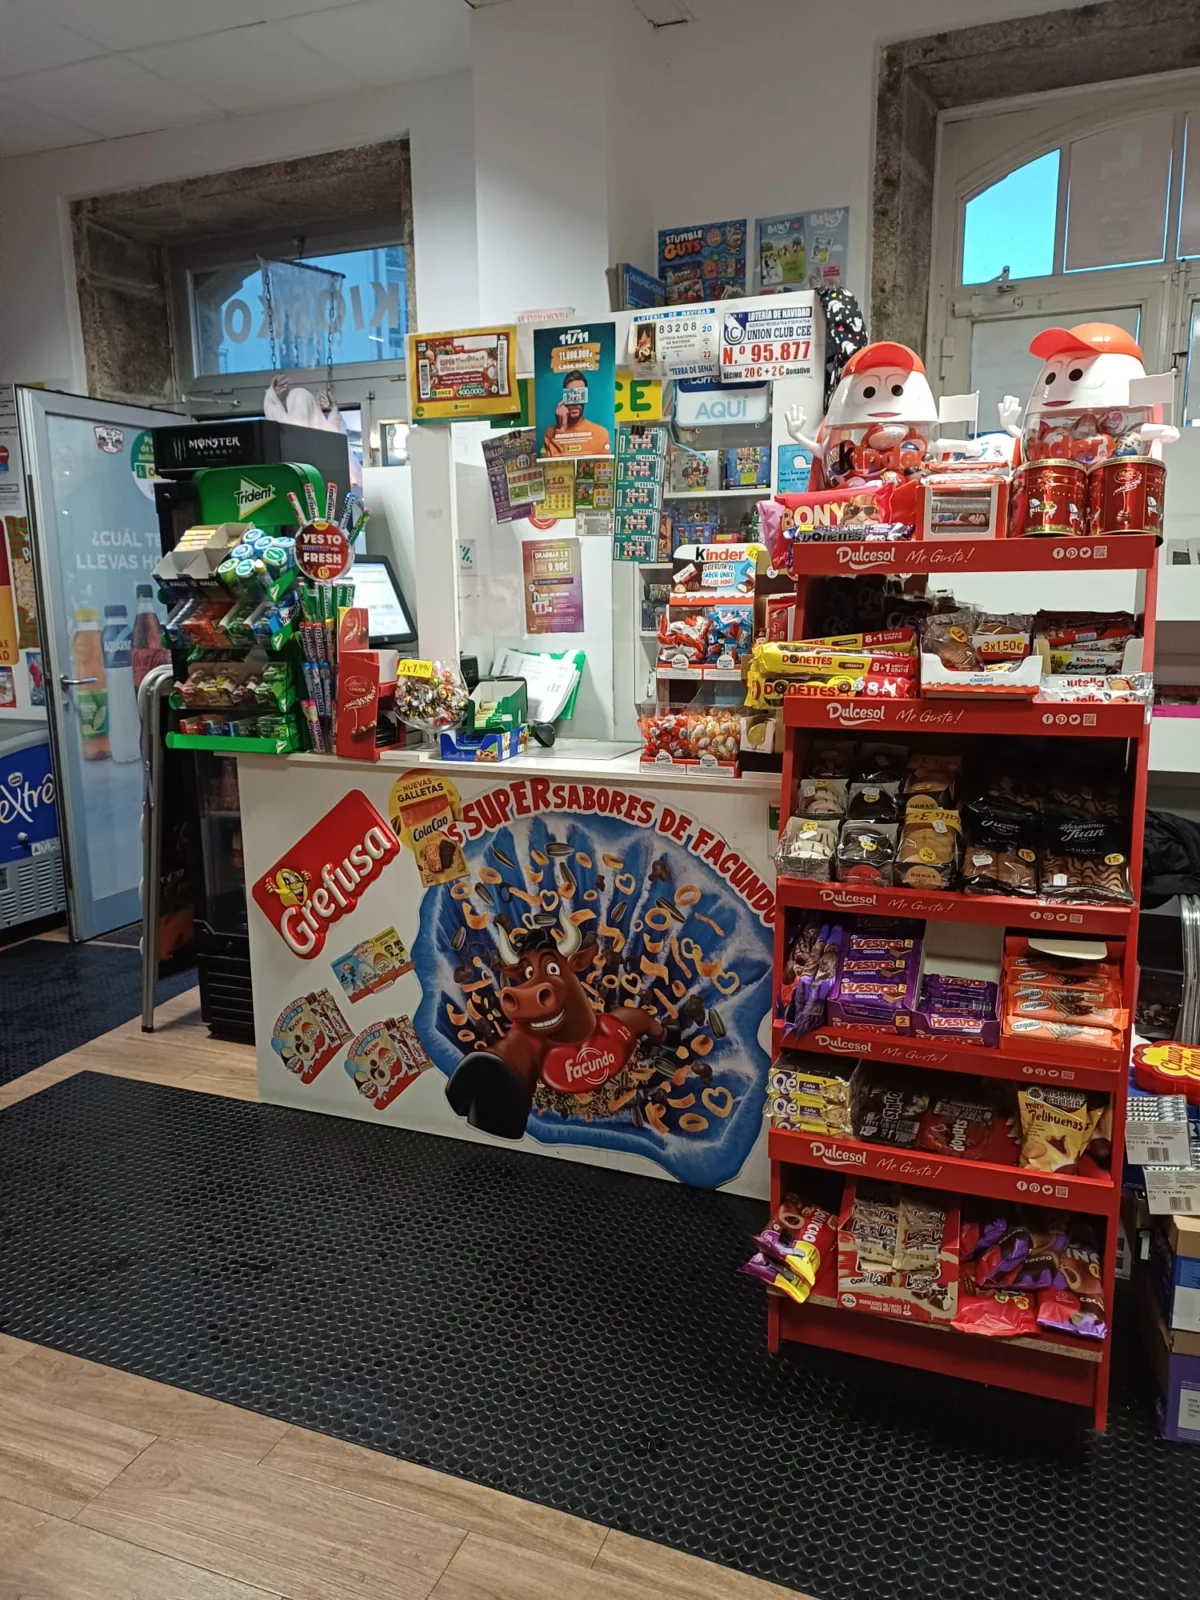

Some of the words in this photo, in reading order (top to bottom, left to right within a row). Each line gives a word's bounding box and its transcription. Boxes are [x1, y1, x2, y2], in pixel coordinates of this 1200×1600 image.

[767, 221, 791, 234] BLUEY
[665, 230, 702, 245] STUMBLE
[664, 240, 701, 261] GUYS
[748, 308, 772, 321] LOTERÍA
[772, 308, 782, 320] DE
[782, 306, 811, 319] NAVIDAD
[659, 321, 697, 334] 83208
[701, 325, 712, 333] 20
[747, 327, 772, 341] UNION
[773, 325, 794, 339] CLUB
[795, 324, 811, 337] CEE
[558, 331, 590, 345] 11/11
[702, 350, 711, 358] 22
[750, 340, 811, 363] 95.877
[689, 366, 697, 374] DE
[785, 366, 811, 376] Donativo
[188, 436, 241, 450] MONSTER
[234, 485, 275, 506] Trident
[781, 502, 846, 529] BONY
[92, 526, 143, 547] ¿CUÁL
[302, 533, 326, 544] YES
[326, 534, 342, 544] TO
[76, 553, 138, 570] LLEVAS
[303, 553, 342, 564] FRESH
[836, 546, 896, 568] Dulcesol
[906, 549, 928, 564] Me
[865, 632, 883, 643] 8+1
[871, 661, 891, 672] 8+1
[1065, 661, 1107, 671] bueno
[826, 702, 885, 723] Dulcesol
[895, 708, 917, 723] Me
[402, 777, 434, 792] NUEVAS
[397, 782, 444, 803] GALLETAS
[412, 814, 449, 843] ColaCao
[659, 810, 694, 843] DE
[1058, 822, 1107, 832] Hermanos
[1060, 827, 1106, 842] Juan
[280, 825, 393, 956] Grefusa
[819, 889, 878, 907] Dulcesol
[886, 898, 908, 910] Me
[841, 983, 899, 995] HUESITOS
[1021, 1002, 1051, 1010] conguitos
[899, 1018, 907, 1026] 2
[930, 1017, 982, 1028] HUESITOS
[1011, 1022, 1043, 1030] conguitos
[617, 1025, 632, 1041] 13
[815, 1035, 873, 1053] Dulcesol
[881, 1047, 902, 1058] Me
[882, 1090, 903, 1120] onuts
[950, 1118, 968, 1152] donuts
[809, 1141, 867, 1165] Dulcesol
[876, 1157, 897, 1171] Me
[1024, 1255, 1053, 1264] cacao
